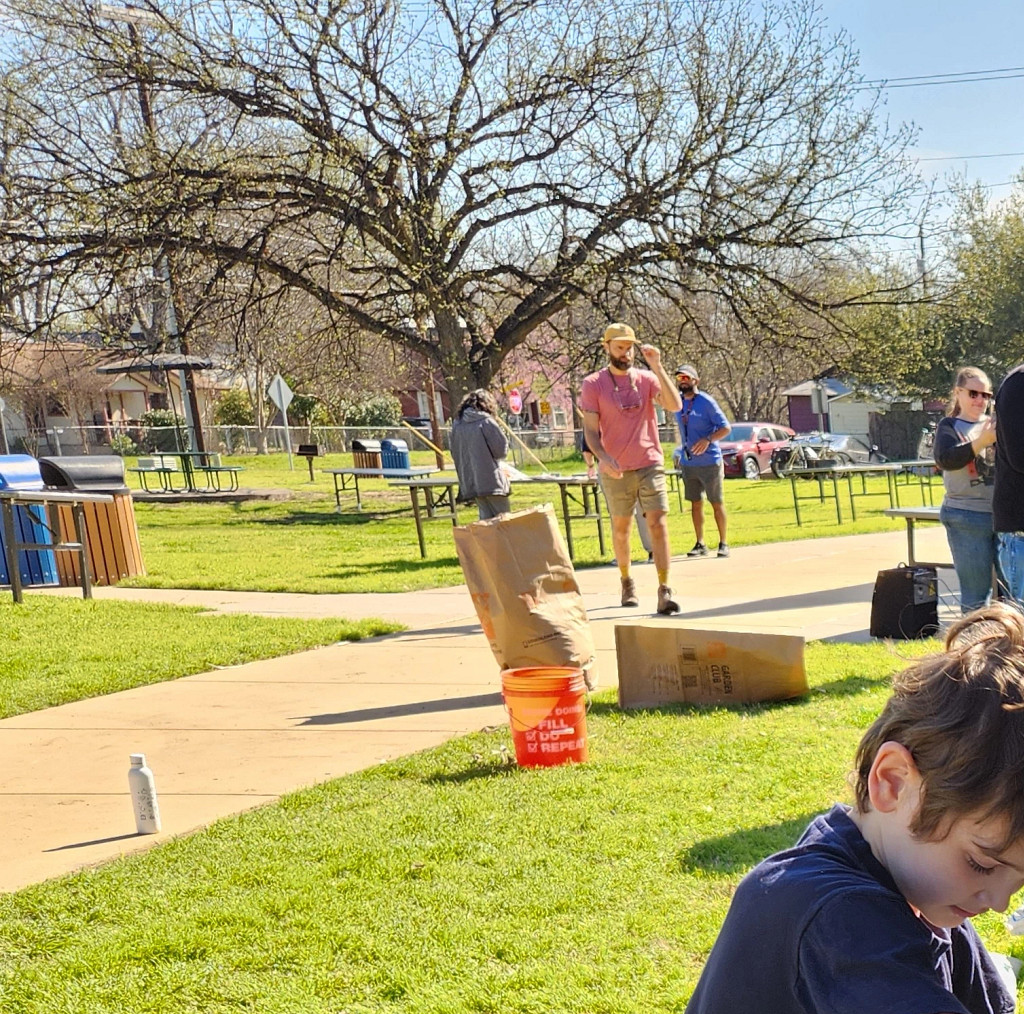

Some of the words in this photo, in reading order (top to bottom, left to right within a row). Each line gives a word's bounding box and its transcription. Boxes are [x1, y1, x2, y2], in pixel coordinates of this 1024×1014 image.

[711, 664, 721, 684] CLUB
[721, 665, 733, 695] GARDEN
[539, 719, 568, 730] FILL
